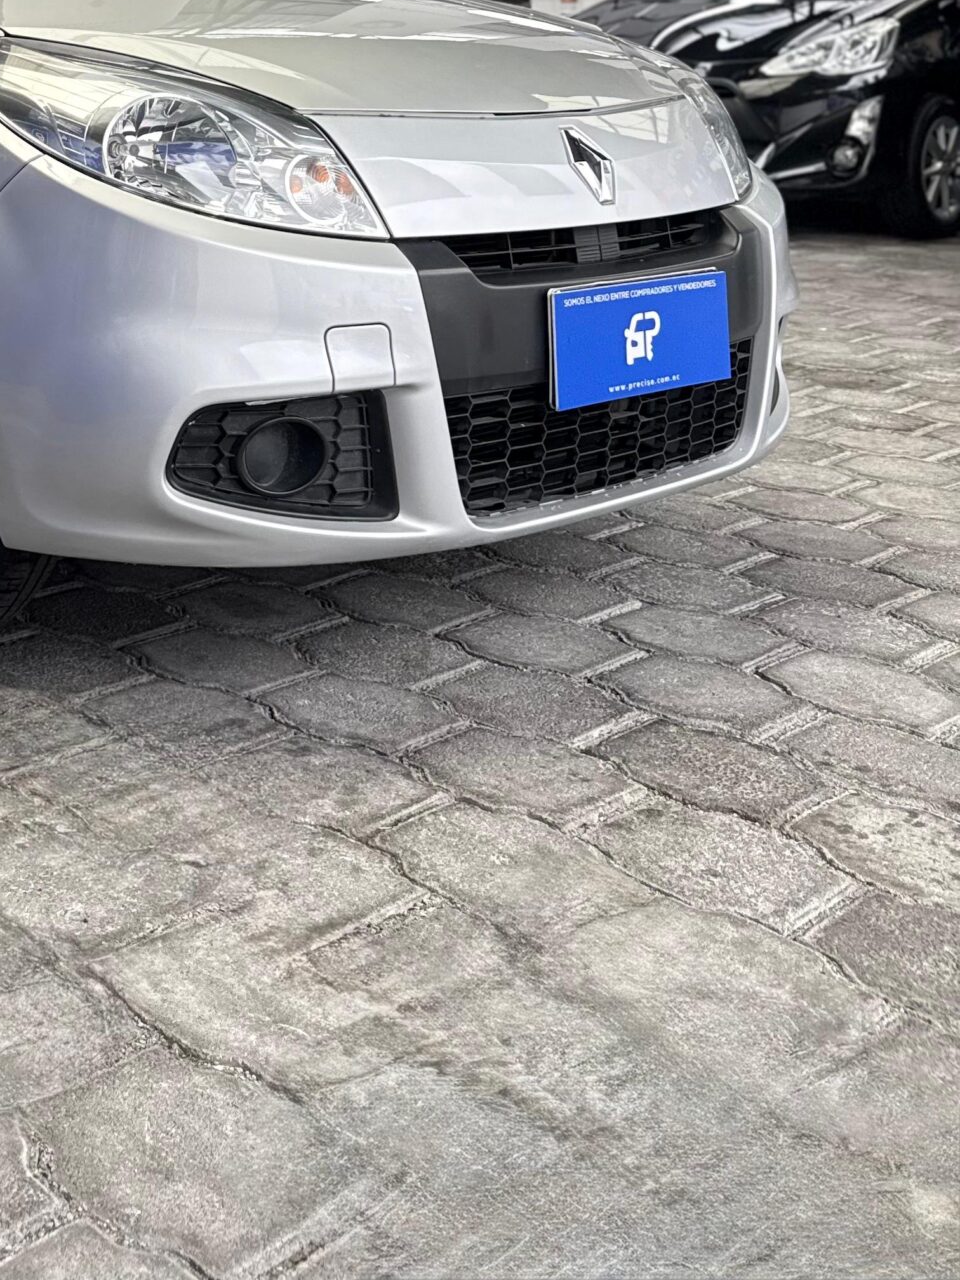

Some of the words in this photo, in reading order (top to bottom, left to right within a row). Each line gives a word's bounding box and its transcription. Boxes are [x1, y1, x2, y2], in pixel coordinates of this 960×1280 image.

[563, 296, 585, 308] SOMOS
[585, 295, 593, 304] EL
[593, 293, 610, 303] NEXO
[610, 290, 630, 301] ENTRE
[630, 285, 673, 298] COMPRADORES
[677, 279, 717, 292] VENDEDORES
